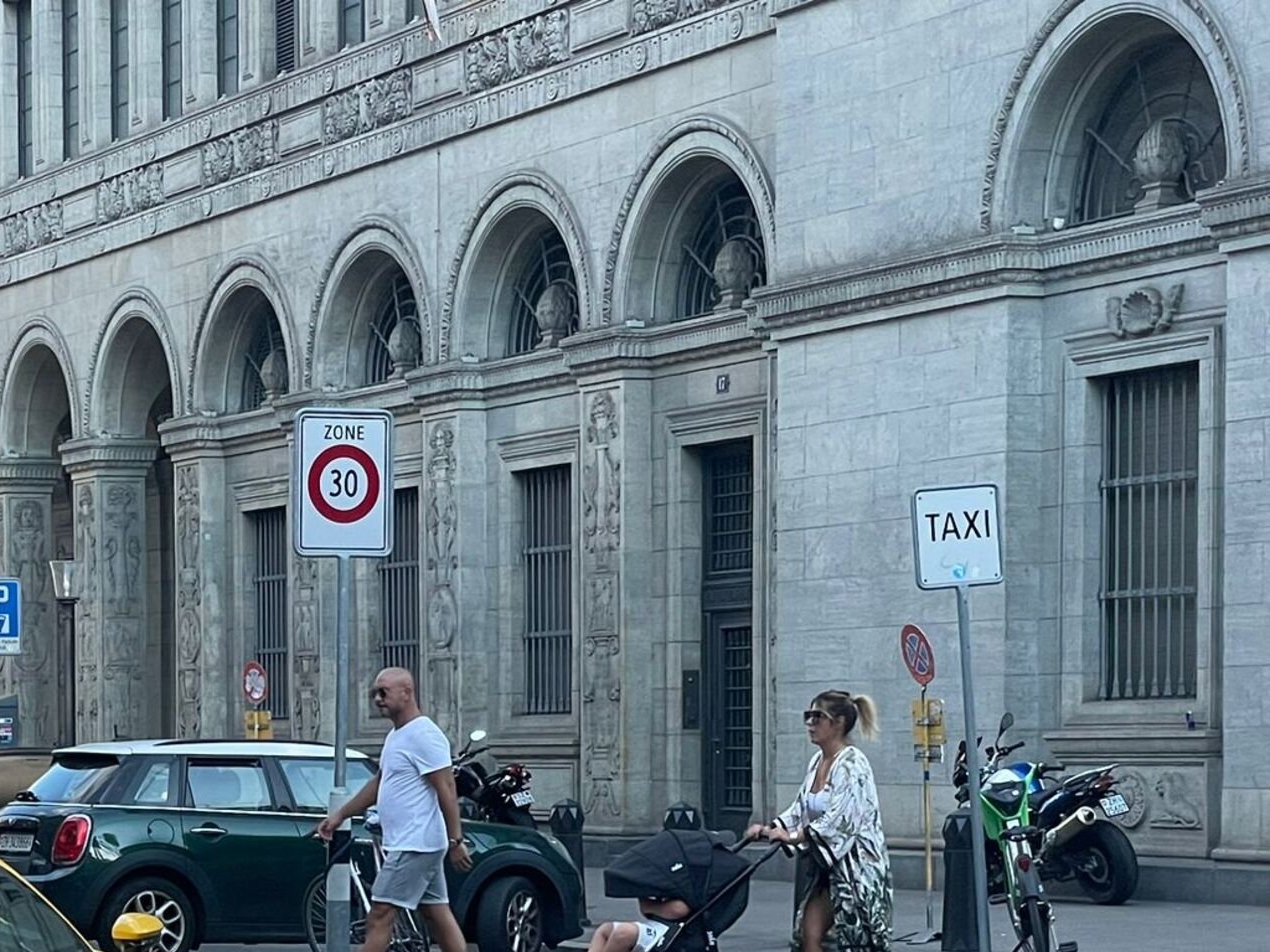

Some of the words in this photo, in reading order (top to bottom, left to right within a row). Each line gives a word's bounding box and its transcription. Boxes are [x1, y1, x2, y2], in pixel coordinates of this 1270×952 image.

[324, 424, 365, 441] ZONE
[329, 469, 358, 497] 30
[925, 509, 991, 543] TAXI
